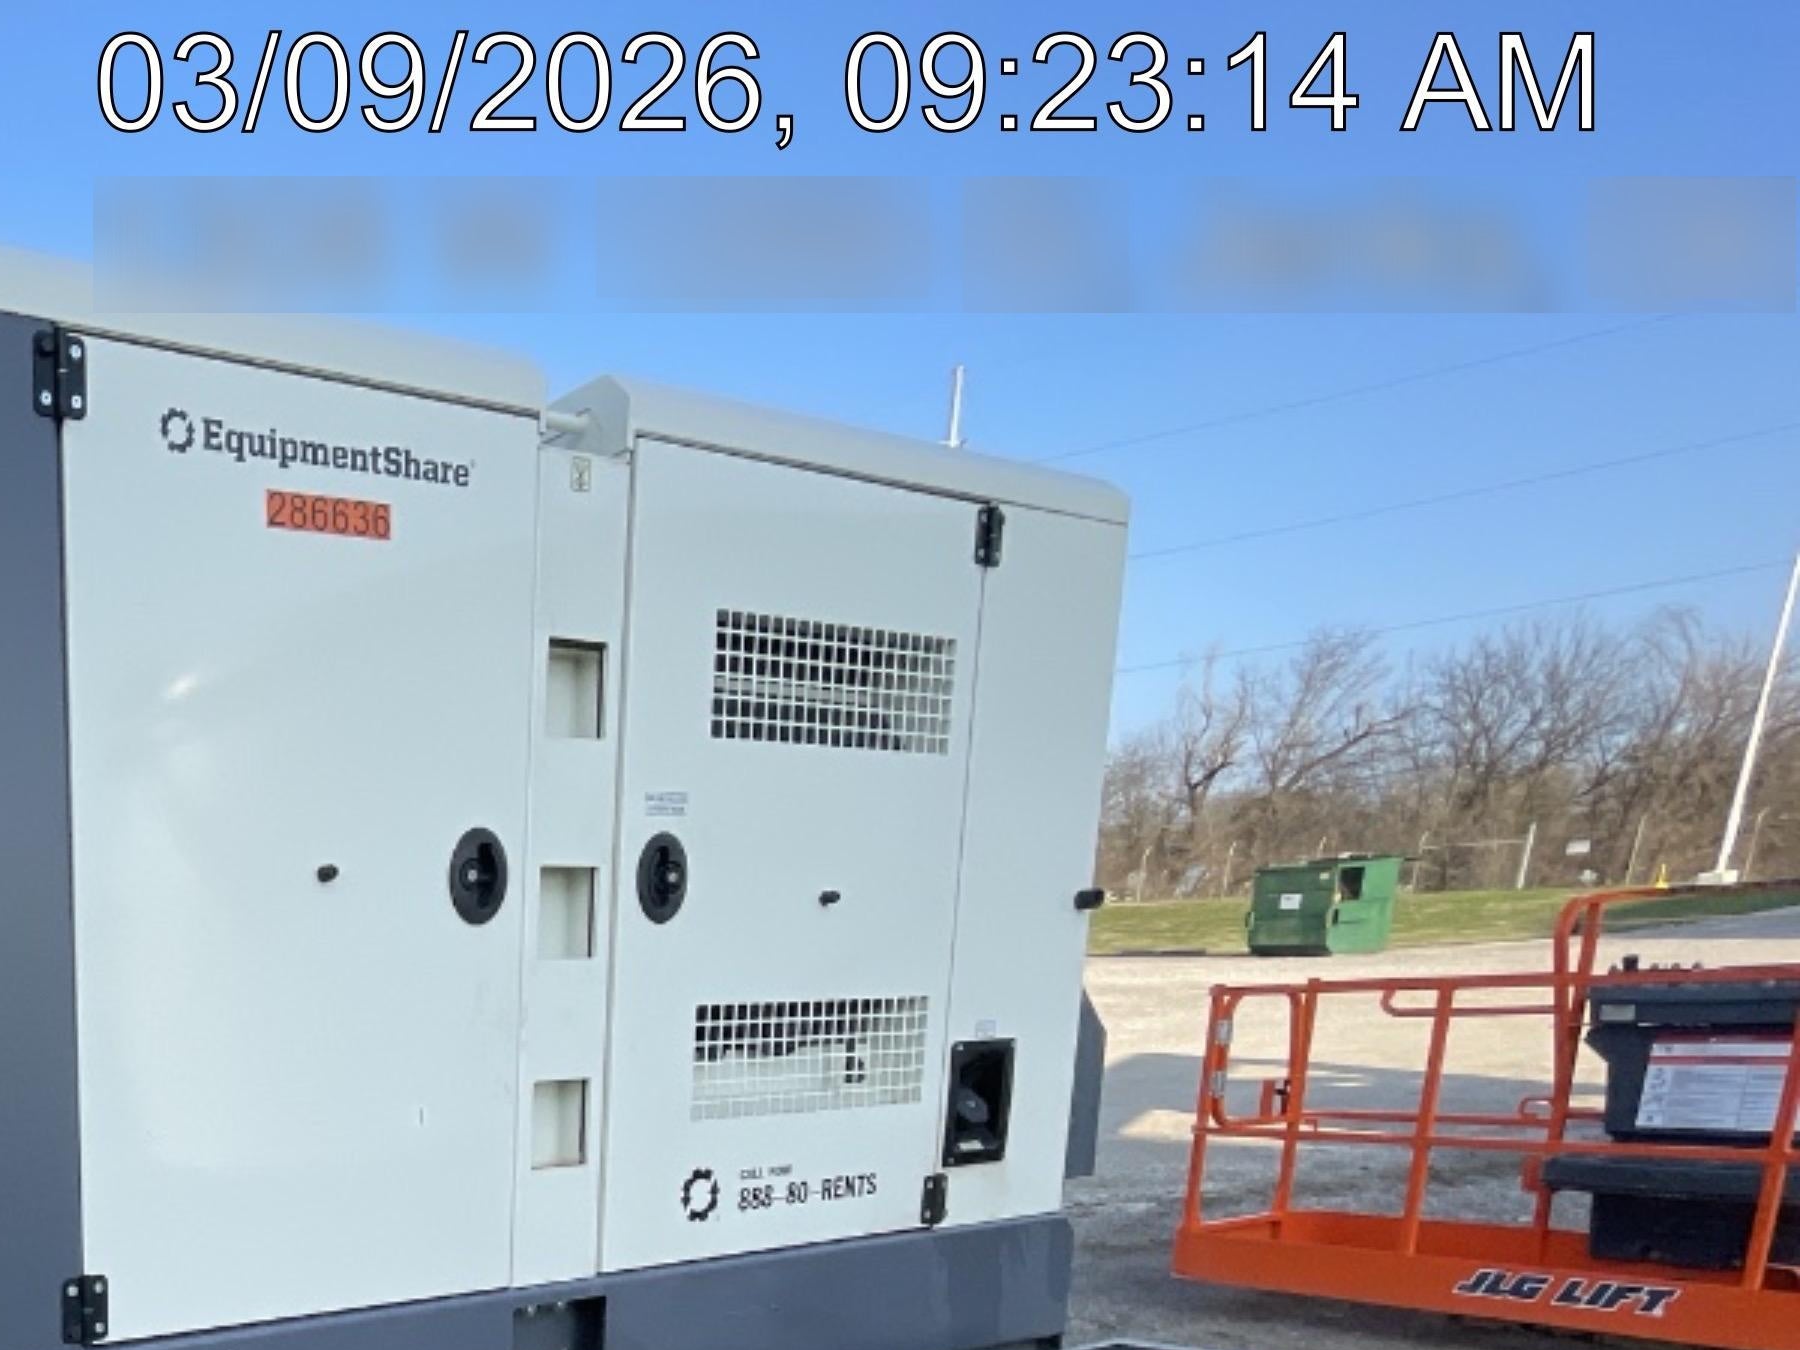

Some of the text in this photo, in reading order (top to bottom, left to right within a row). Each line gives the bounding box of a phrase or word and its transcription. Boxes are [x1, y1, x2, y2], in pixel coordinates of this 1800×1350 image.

[202, 416, 470, 487] EquipmentShare
[268, 491, 391, 538] 286636
[1452, 1268, 1682, 1316] JLG LIFT
